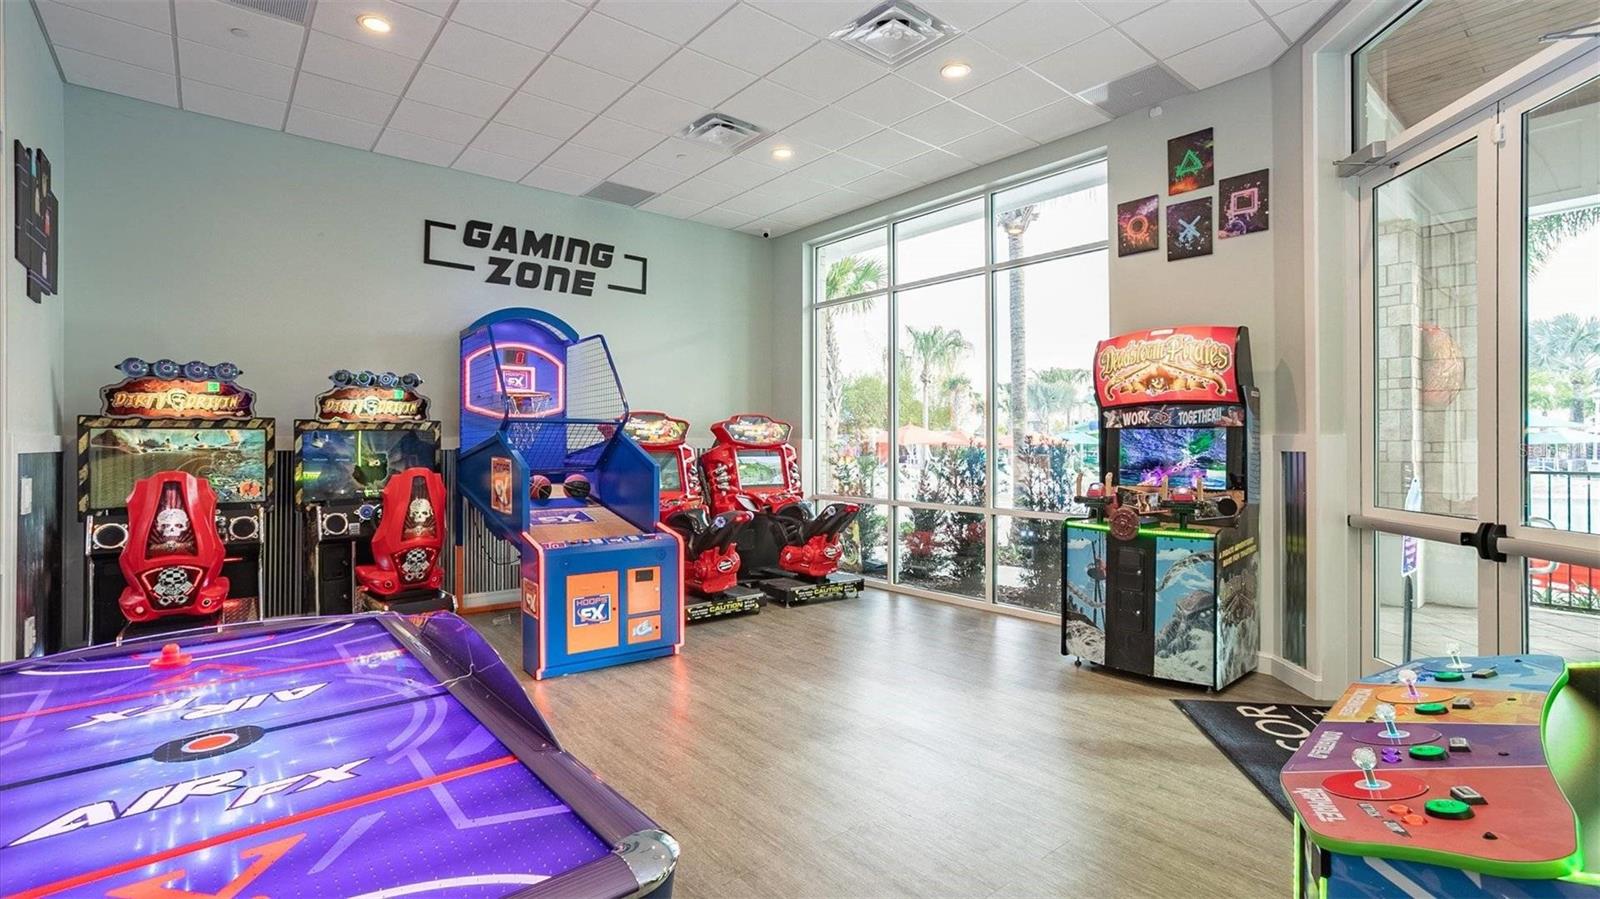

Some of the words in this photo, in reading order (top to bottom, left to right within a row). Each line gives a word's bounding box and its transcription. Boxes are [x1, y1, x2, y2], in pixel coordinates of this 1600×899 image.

[463, 219, 615, 269] GAMING
[485, 256, 596, 297] ZONE
[1163, 334, 1231, 371] Pirates
[113, 392, 167, 410] DIRTY
[1122, 411, 1151, 426] WORK
[813, 586, 844, 596] CAUTION
[576, 596, 608, 607] HOOPS
[709, 601, 744, 613] CAUTION
[579, 603, 607, 621] FX
[1, 768, 249, 849] AIR
[225, 756, 375, 811] FX
